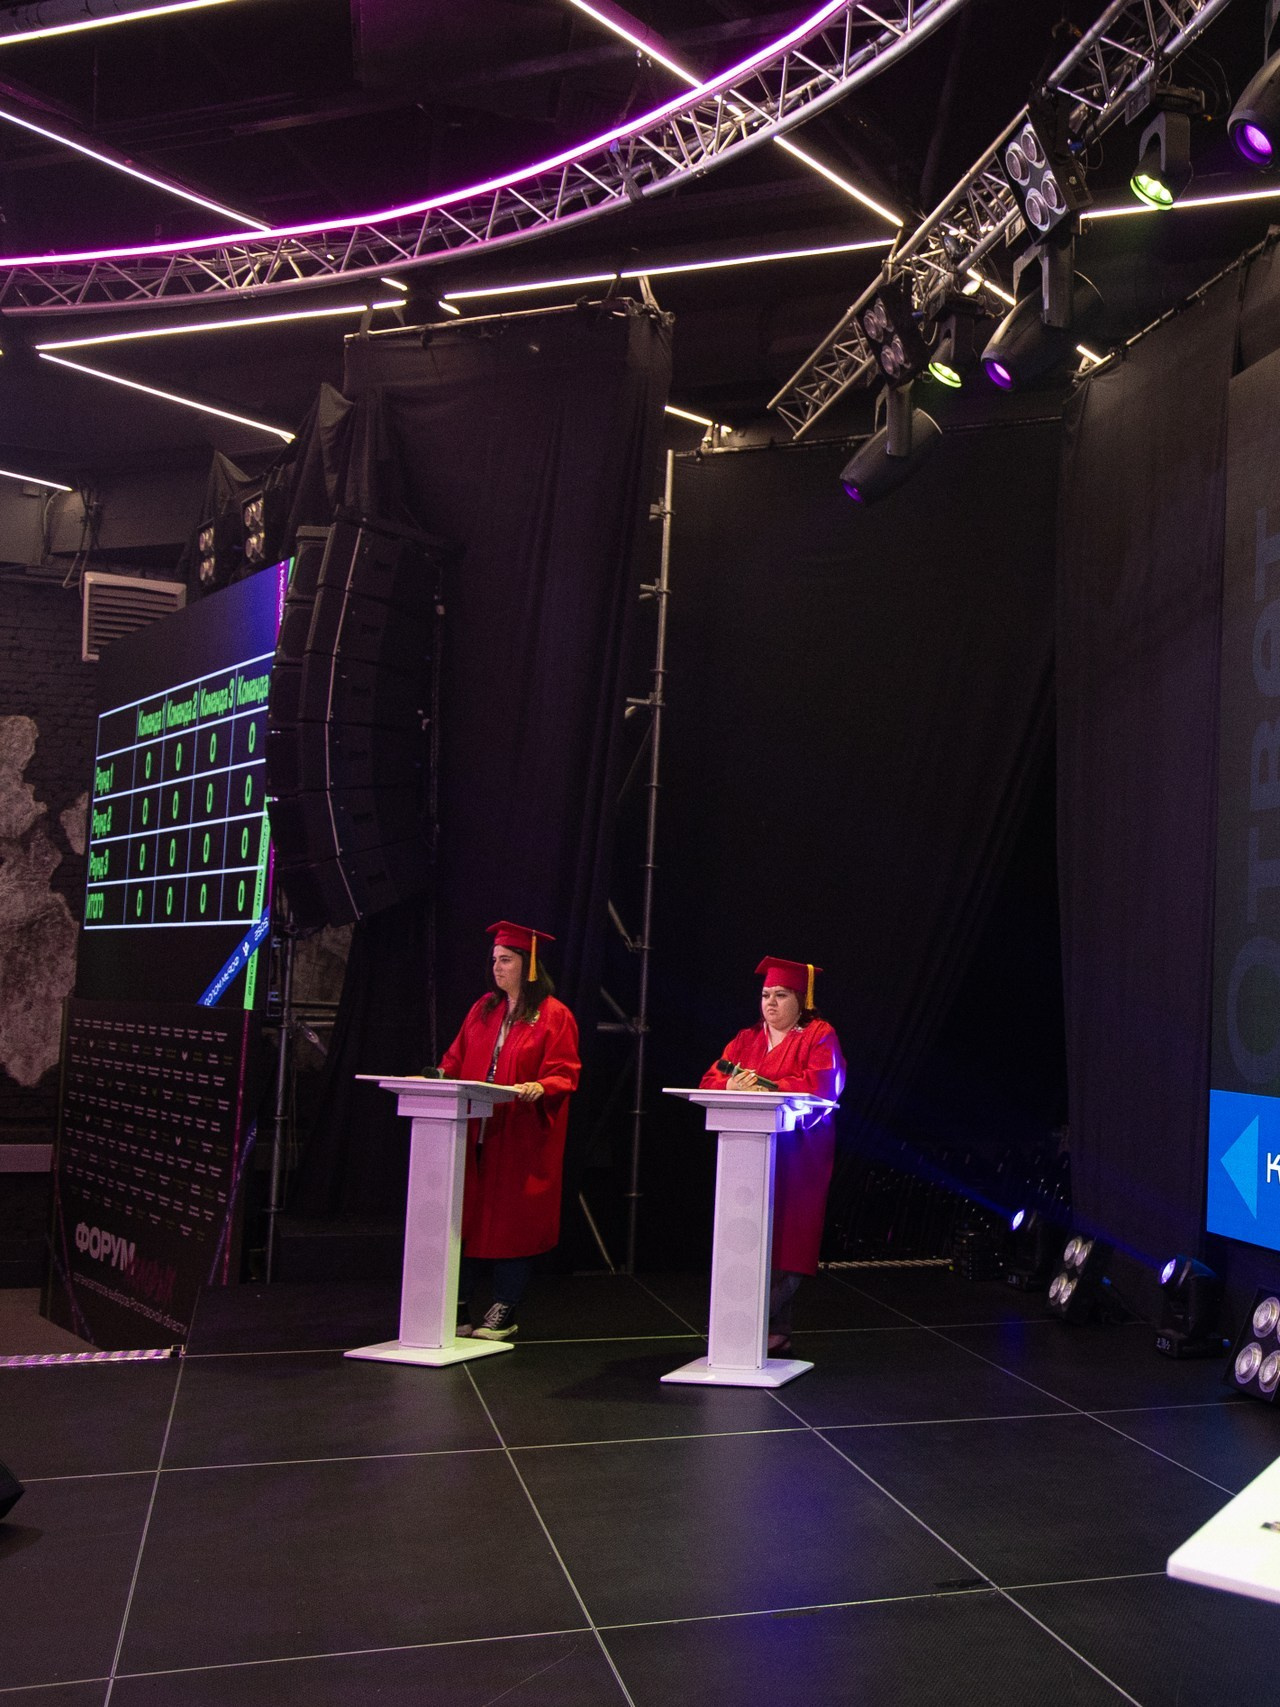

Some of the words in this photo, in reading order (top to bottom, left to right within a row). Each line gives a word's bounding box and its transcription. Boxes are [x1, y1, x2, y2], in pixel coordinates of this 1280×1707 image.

[166, 699, 193, 727] Команда
[192, 690, 199, 720] 2
[200, 688, 229, 717] Команда
[228, 677, 235, 708] 3
[137, 709, 162, 737] Команда
[145, 751, 152, 779] 0
[175, 742, 183, 771] 0
[209, 732, 217, 763] 0
[248, 722, 257, 753] 0
[142, 797, 149, 825] 0
[172, 790, 179, 819] 0
[206, 783, 214, 813] 0
[244, 774, 253, 806] 0
[139, 843, 146, 871] 0
[169, 838, 176, 867] 0
[202, 832, 210, 863] 0
[240, 827, 249, 859] 0
[136, 889, 143, 917] 0
[166, 886, 173, 915] 0
[199, 883, 207, 913] 0
[237, 879, 246, 912] 0
[75, 1221, 136, 1276] ФОРУМ
